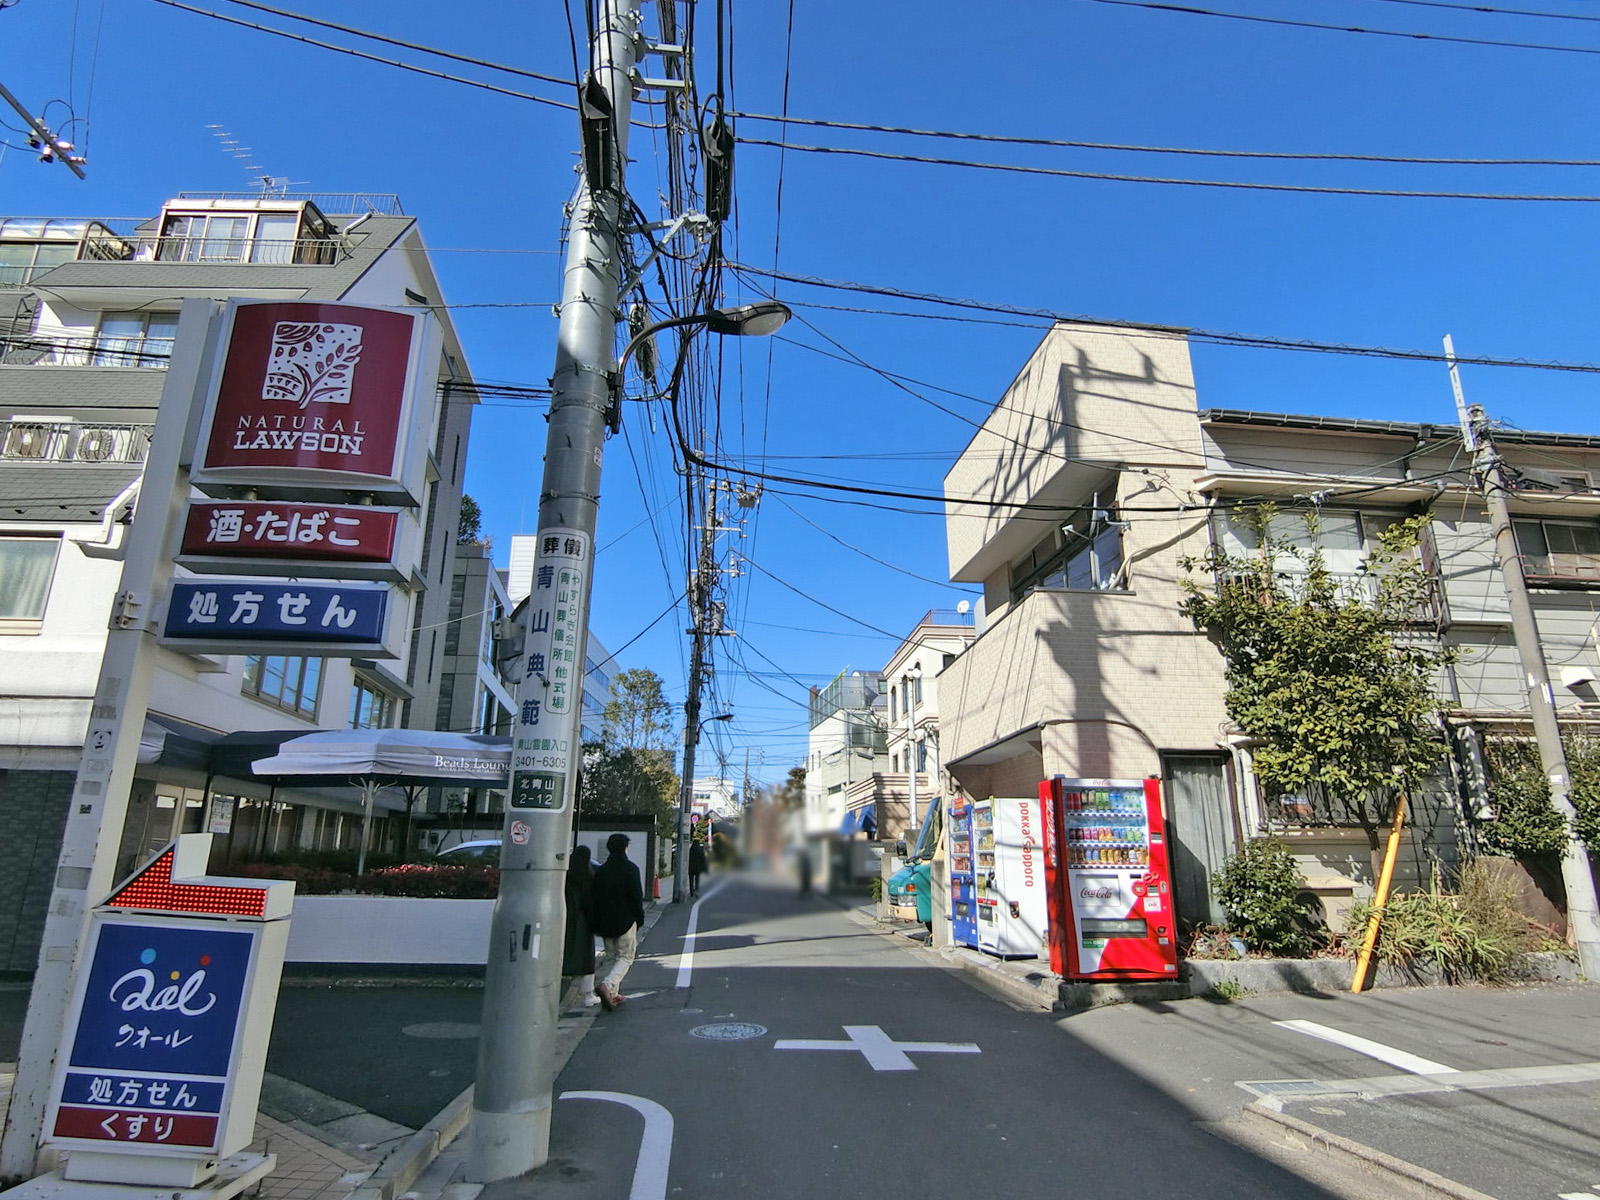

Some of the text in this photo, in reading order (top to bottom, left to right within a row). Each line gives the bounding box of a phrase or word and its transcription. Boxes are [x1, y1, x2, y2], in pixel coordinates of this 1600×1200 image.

[238, 415, 366, 435] NATURAL
[233, 431, 364, 456] LAWSON
[543, 537, 581, 556] 葬儀
[186, 592, 357, 628] 処方せん
[563, 574, 581, 663] やすらぎ会館
[521, 565, 554, 726] 青山典範
[517, 738, 568, 752] 青山霊園入口
[434, 755, 470, 769] Beads
[515, 756, 567, 768] 3401-6305
[520, 778, 556, 790] 北青山
[519, 793, 553, 805] 2-12
[114, 1023, 193, 1049] クオール
[87, 1077, 198, 1108] 処方せん
[100, 1113, 174, 1140] くすり
